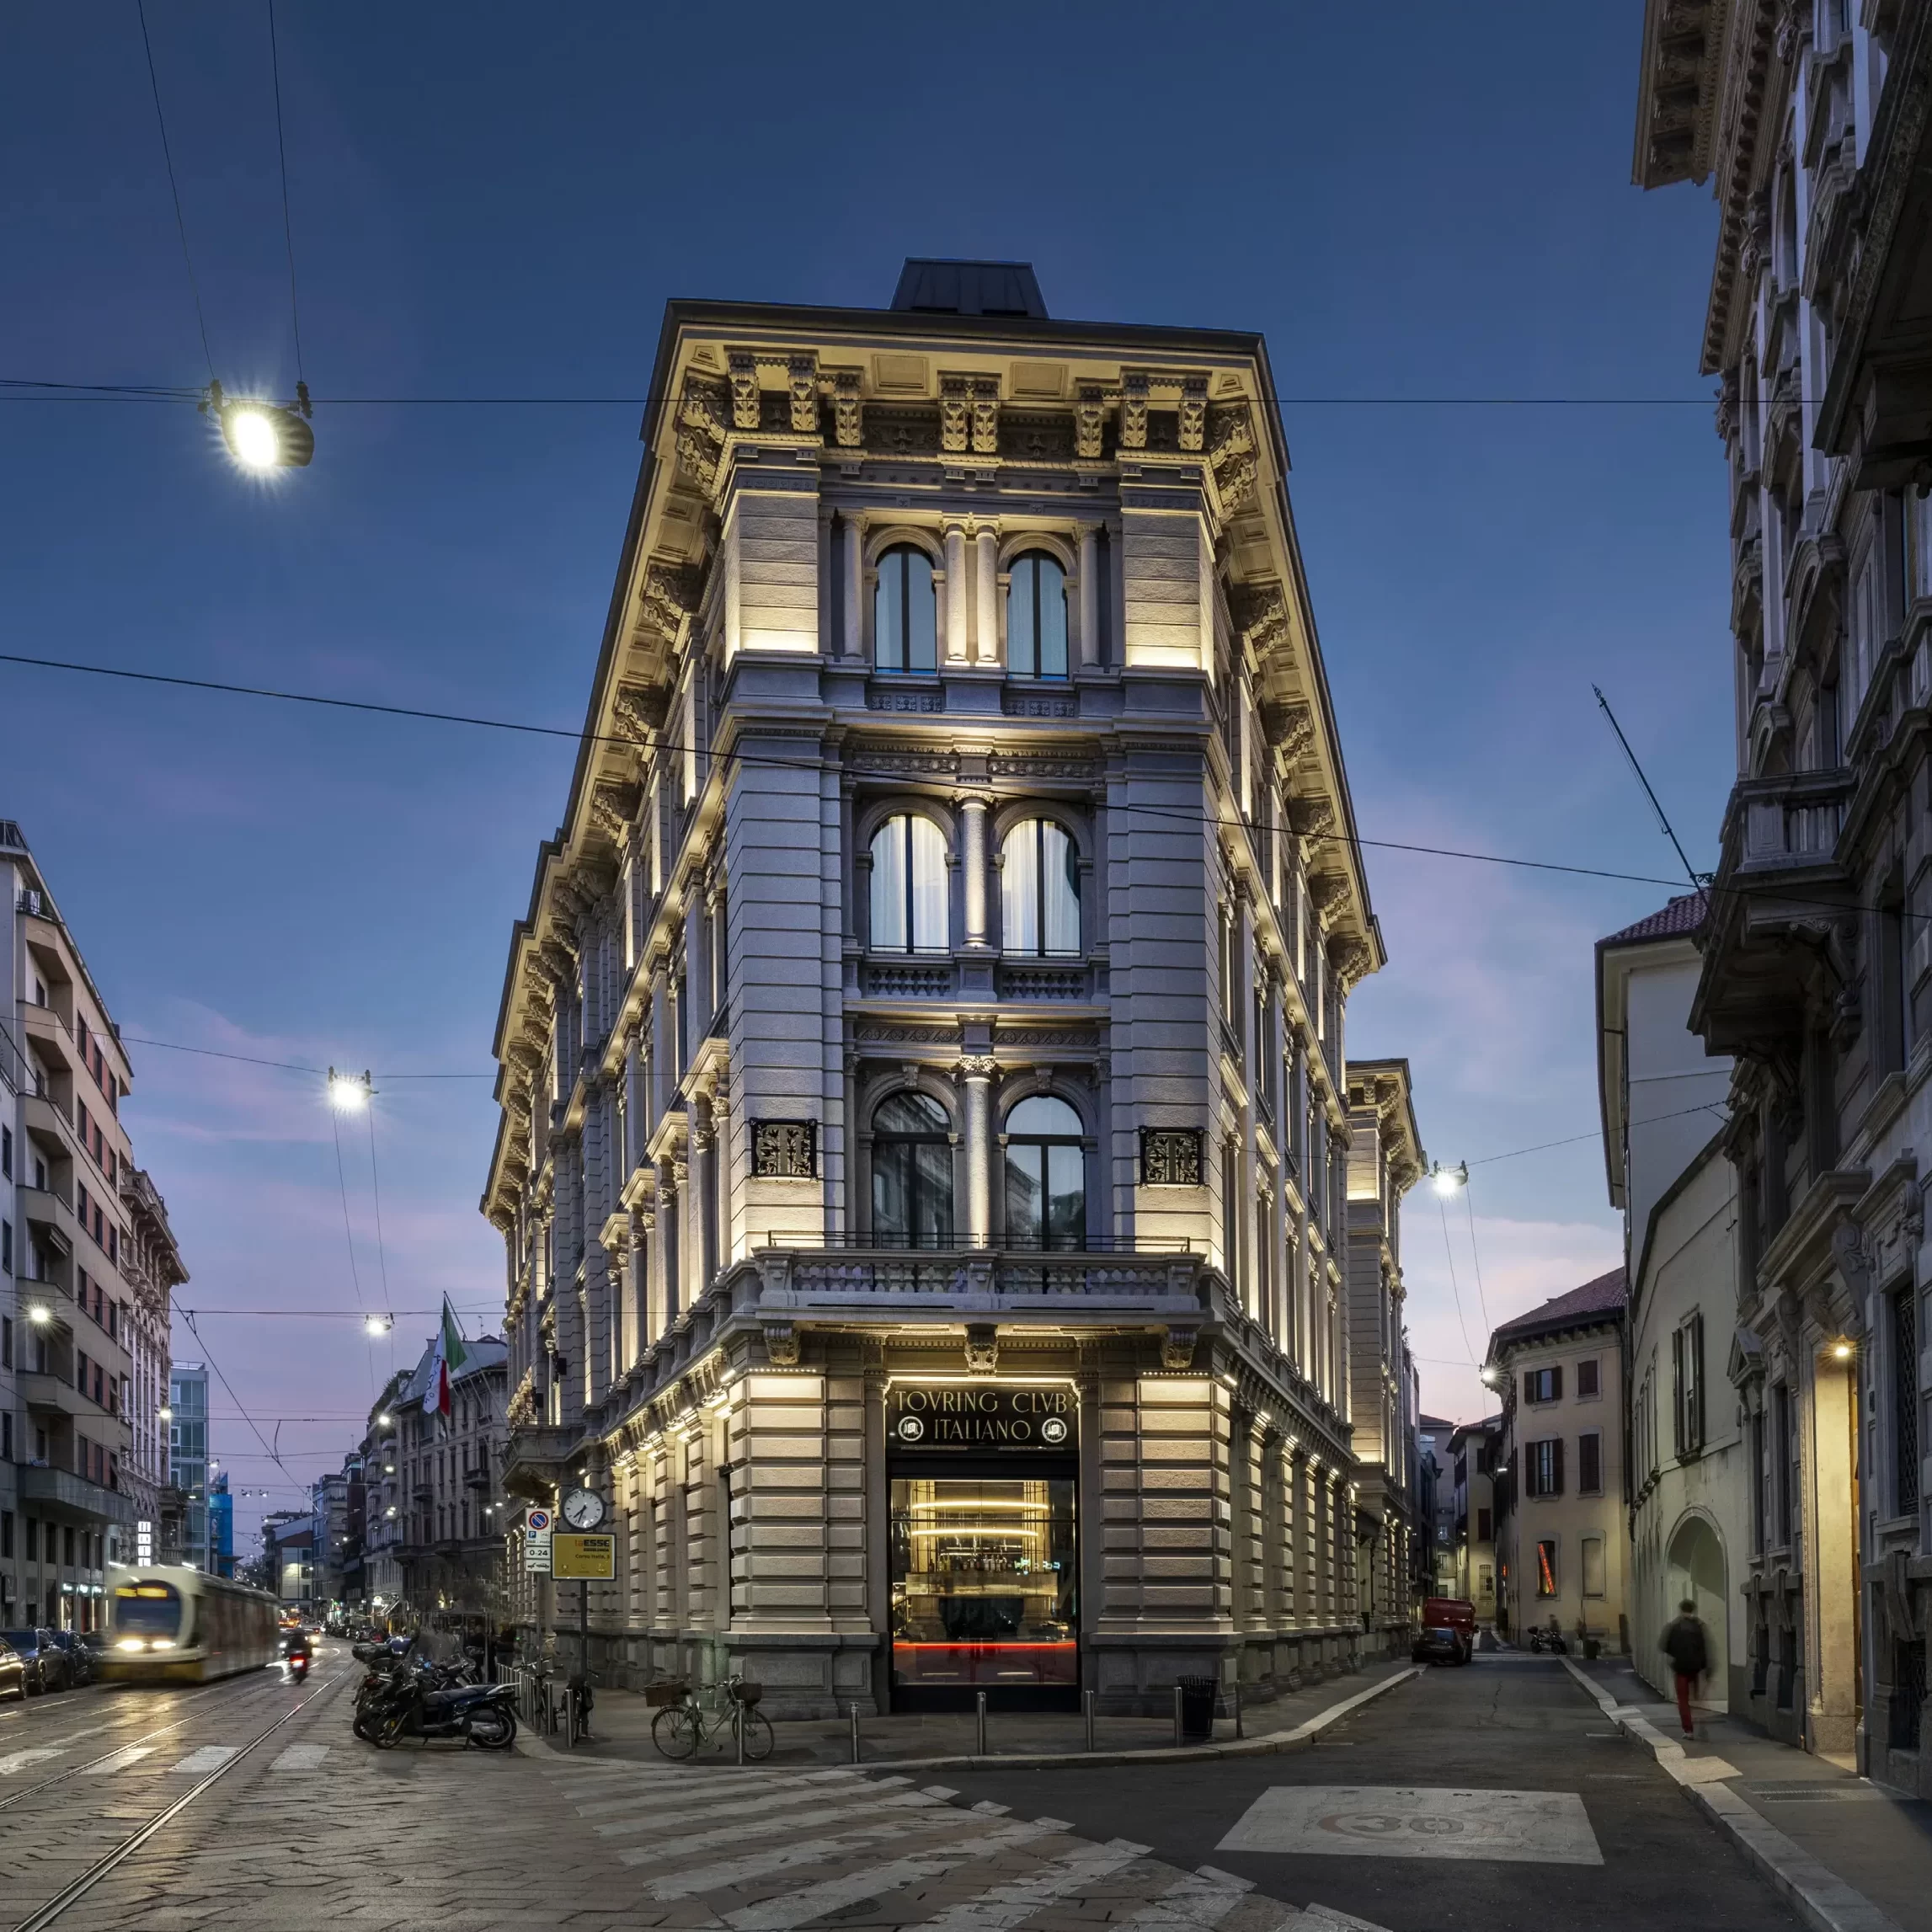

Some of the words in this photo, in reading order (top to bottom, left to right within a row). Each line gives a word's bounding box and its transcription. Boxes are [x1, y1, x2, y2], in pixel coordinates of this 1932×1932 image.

[895, 1390, 998, 1412] TOVRING
[1012, 1391, 1067, 1413] CLVB
[934, 1419, 1031, 1440] ITALIANO
[1351, 1815, 1464, 1834] 30
